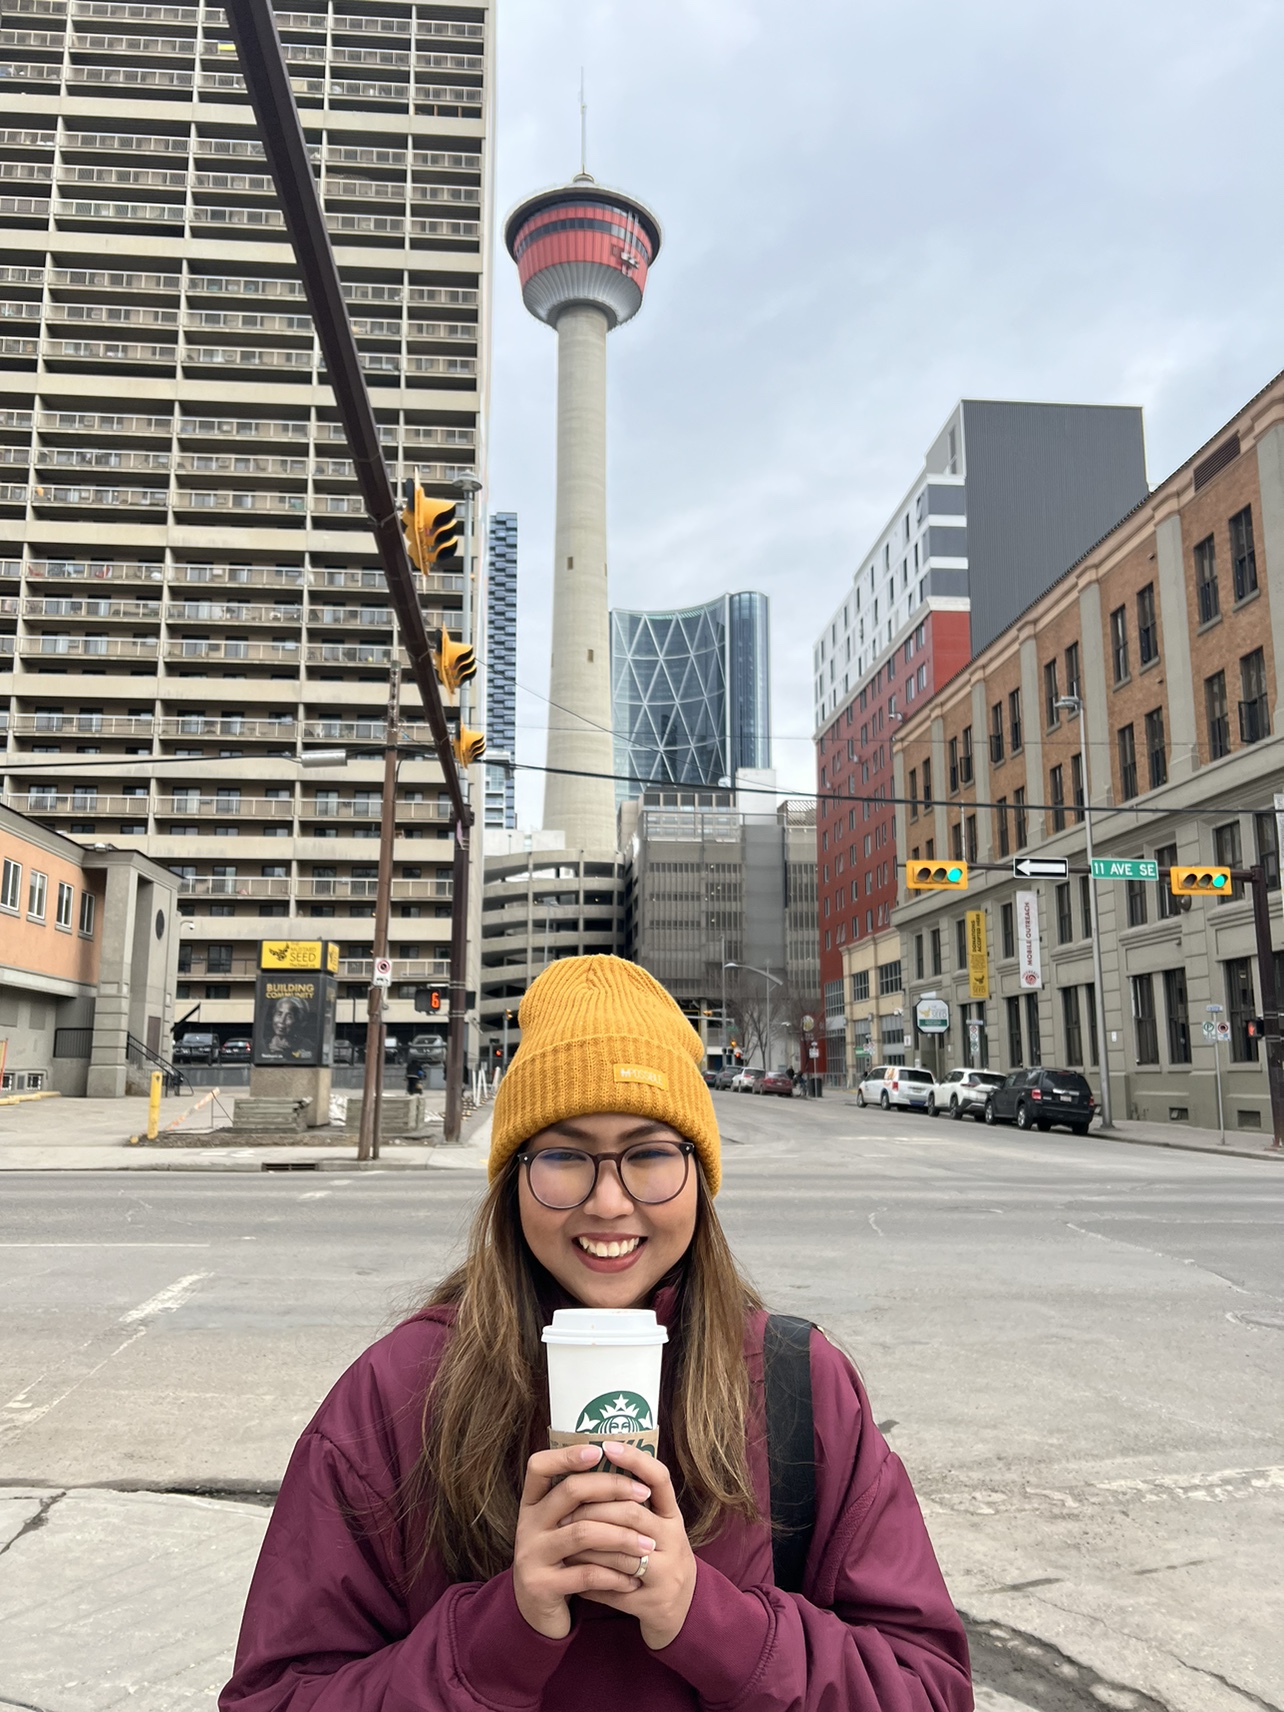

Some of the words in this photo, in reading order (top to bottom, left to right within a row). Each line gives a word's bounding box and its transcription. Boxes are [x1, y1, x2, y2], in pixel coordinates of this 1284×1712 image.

[1094, 862, 1105, 875] 11
[1110, 863, 1133, 876] AVE
[1139, 864, 1155, 876] SE
[289, 952, 317, 962] SEED
[266, 983, 314, 992] BUILDING
[431, 992, 440, 1008] 6
